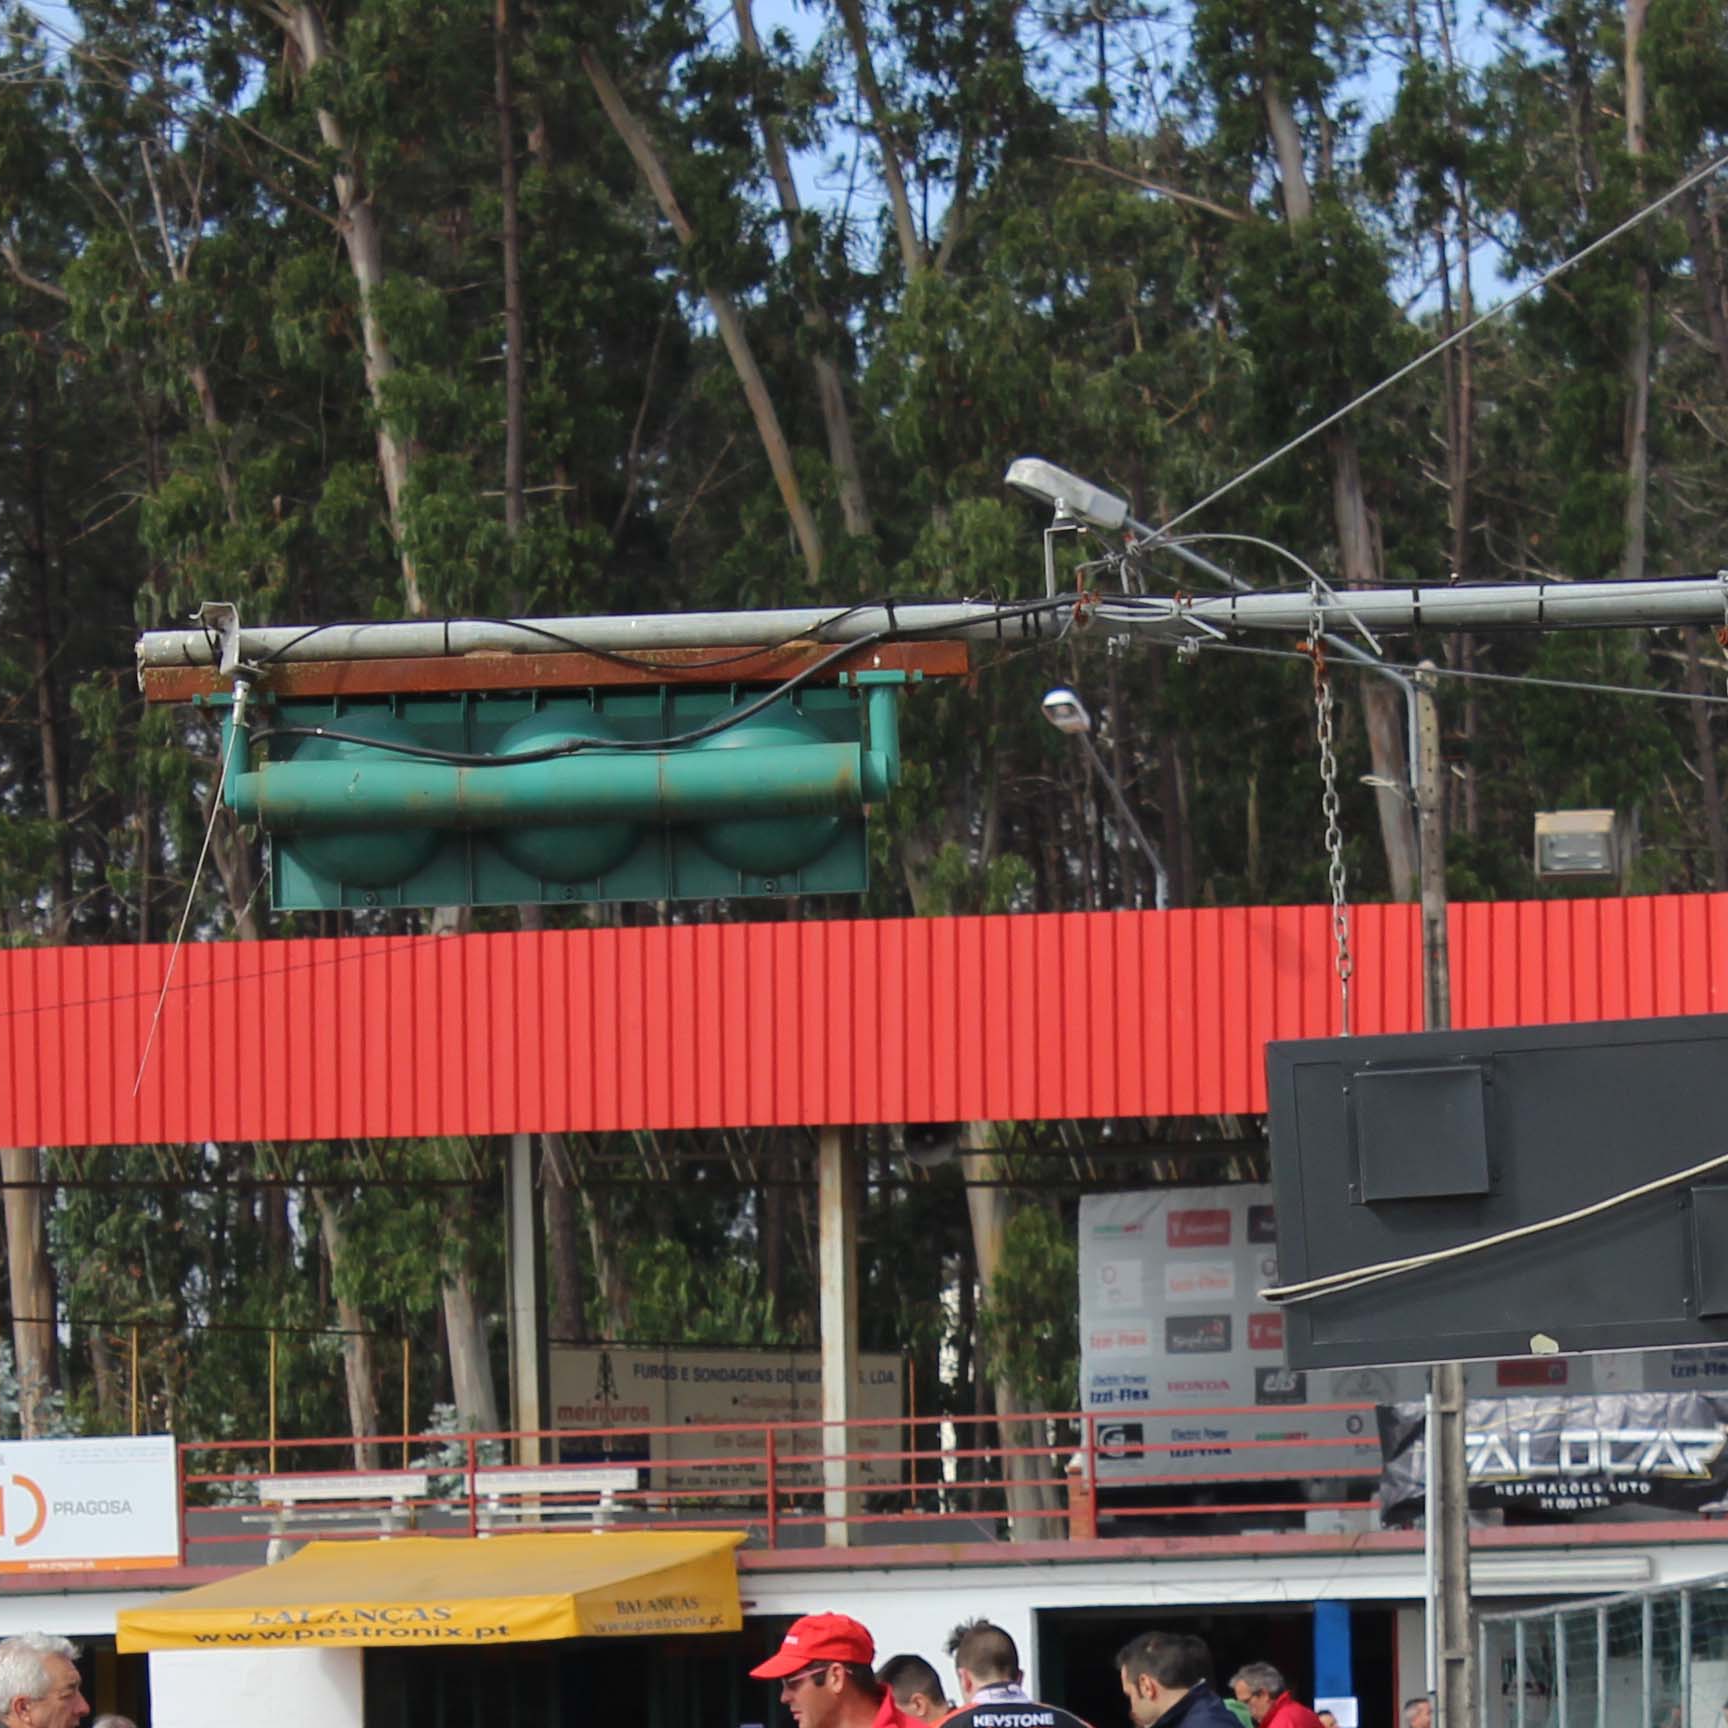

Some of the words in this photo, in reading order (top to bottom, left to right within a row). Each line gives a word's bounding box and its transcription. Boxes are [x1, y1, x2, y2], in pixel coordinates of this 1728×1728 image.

[53, 1499, 133, 1517] PRAGOSA
[615, 1596, 700, 1615] BALANÇAS
[193, 1623, 511, 1643] www.pestronix.pt
